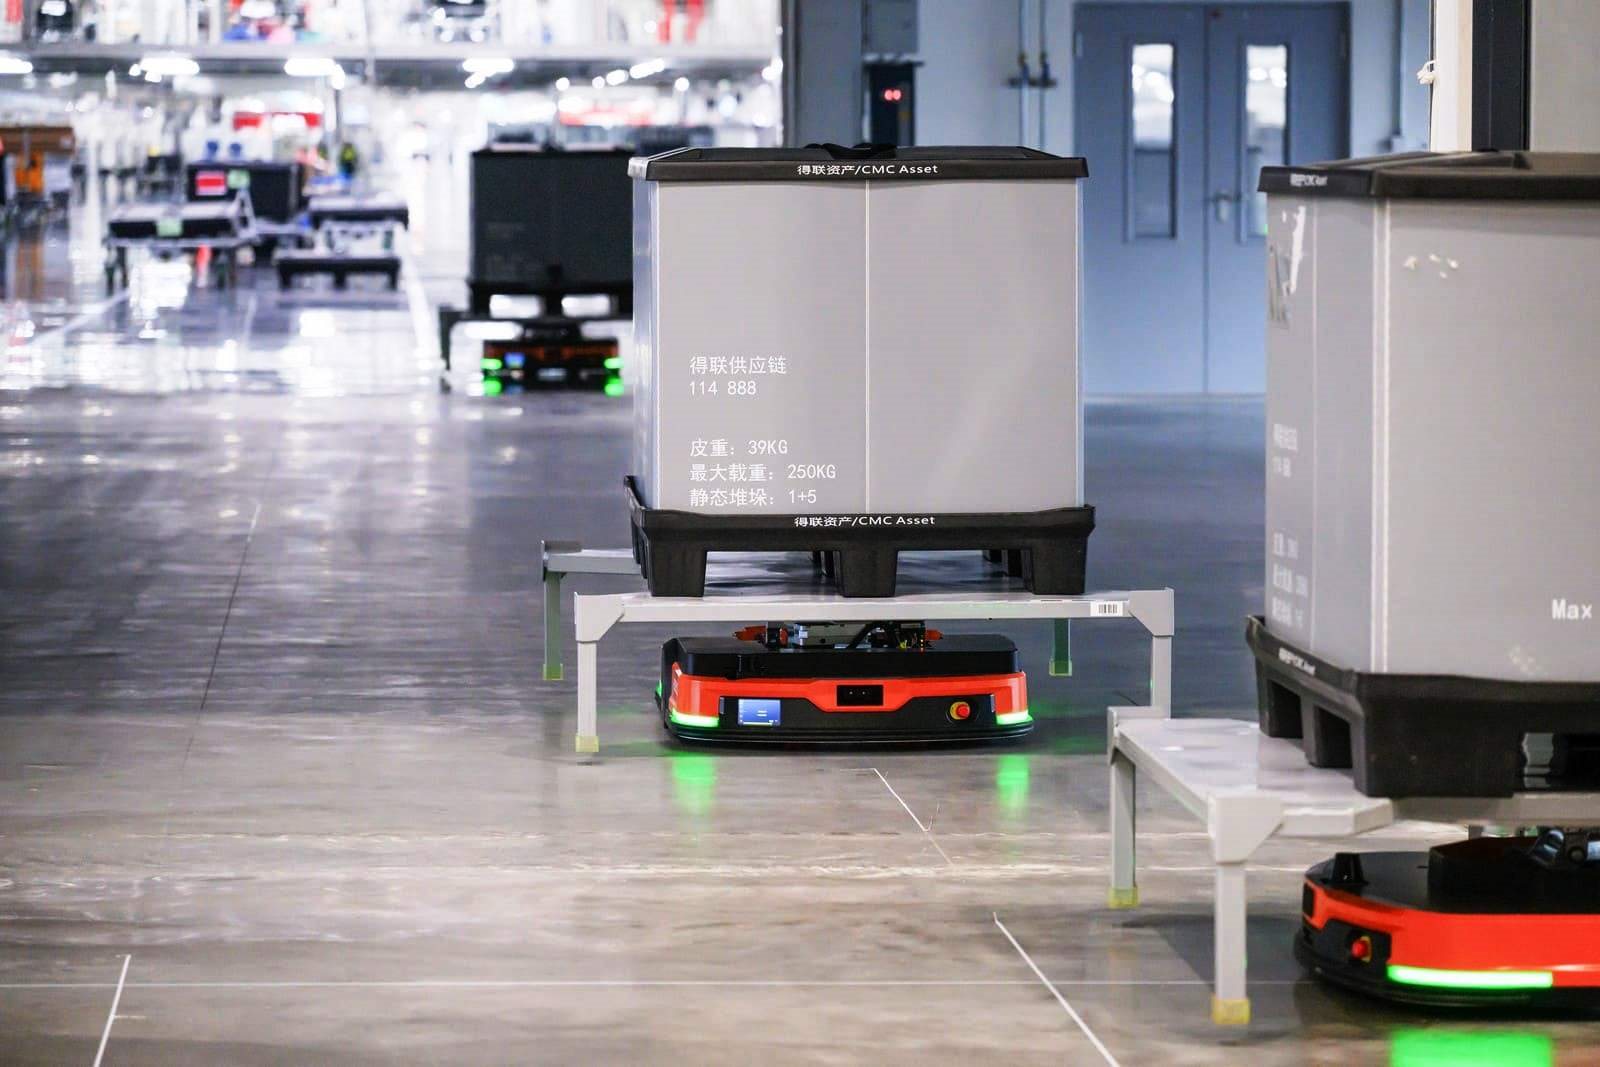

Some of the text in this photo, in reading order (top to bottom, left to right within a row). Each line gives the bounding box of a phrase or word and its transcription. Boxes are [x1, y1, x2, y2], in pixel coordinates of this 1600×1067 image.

[899, 164, 938, 174] Asset
[689, 355, 787, 375] 得联供应链
[689, 380, 757, 396] 114 888
[748, 439, 788, 455] 39KG
[787, 464, 836, 480] 250KG
[788, 489, 817, 504] 1+5
[896, 516, 936, 526] Asset
[1551, 598, 1593, 620] Max
